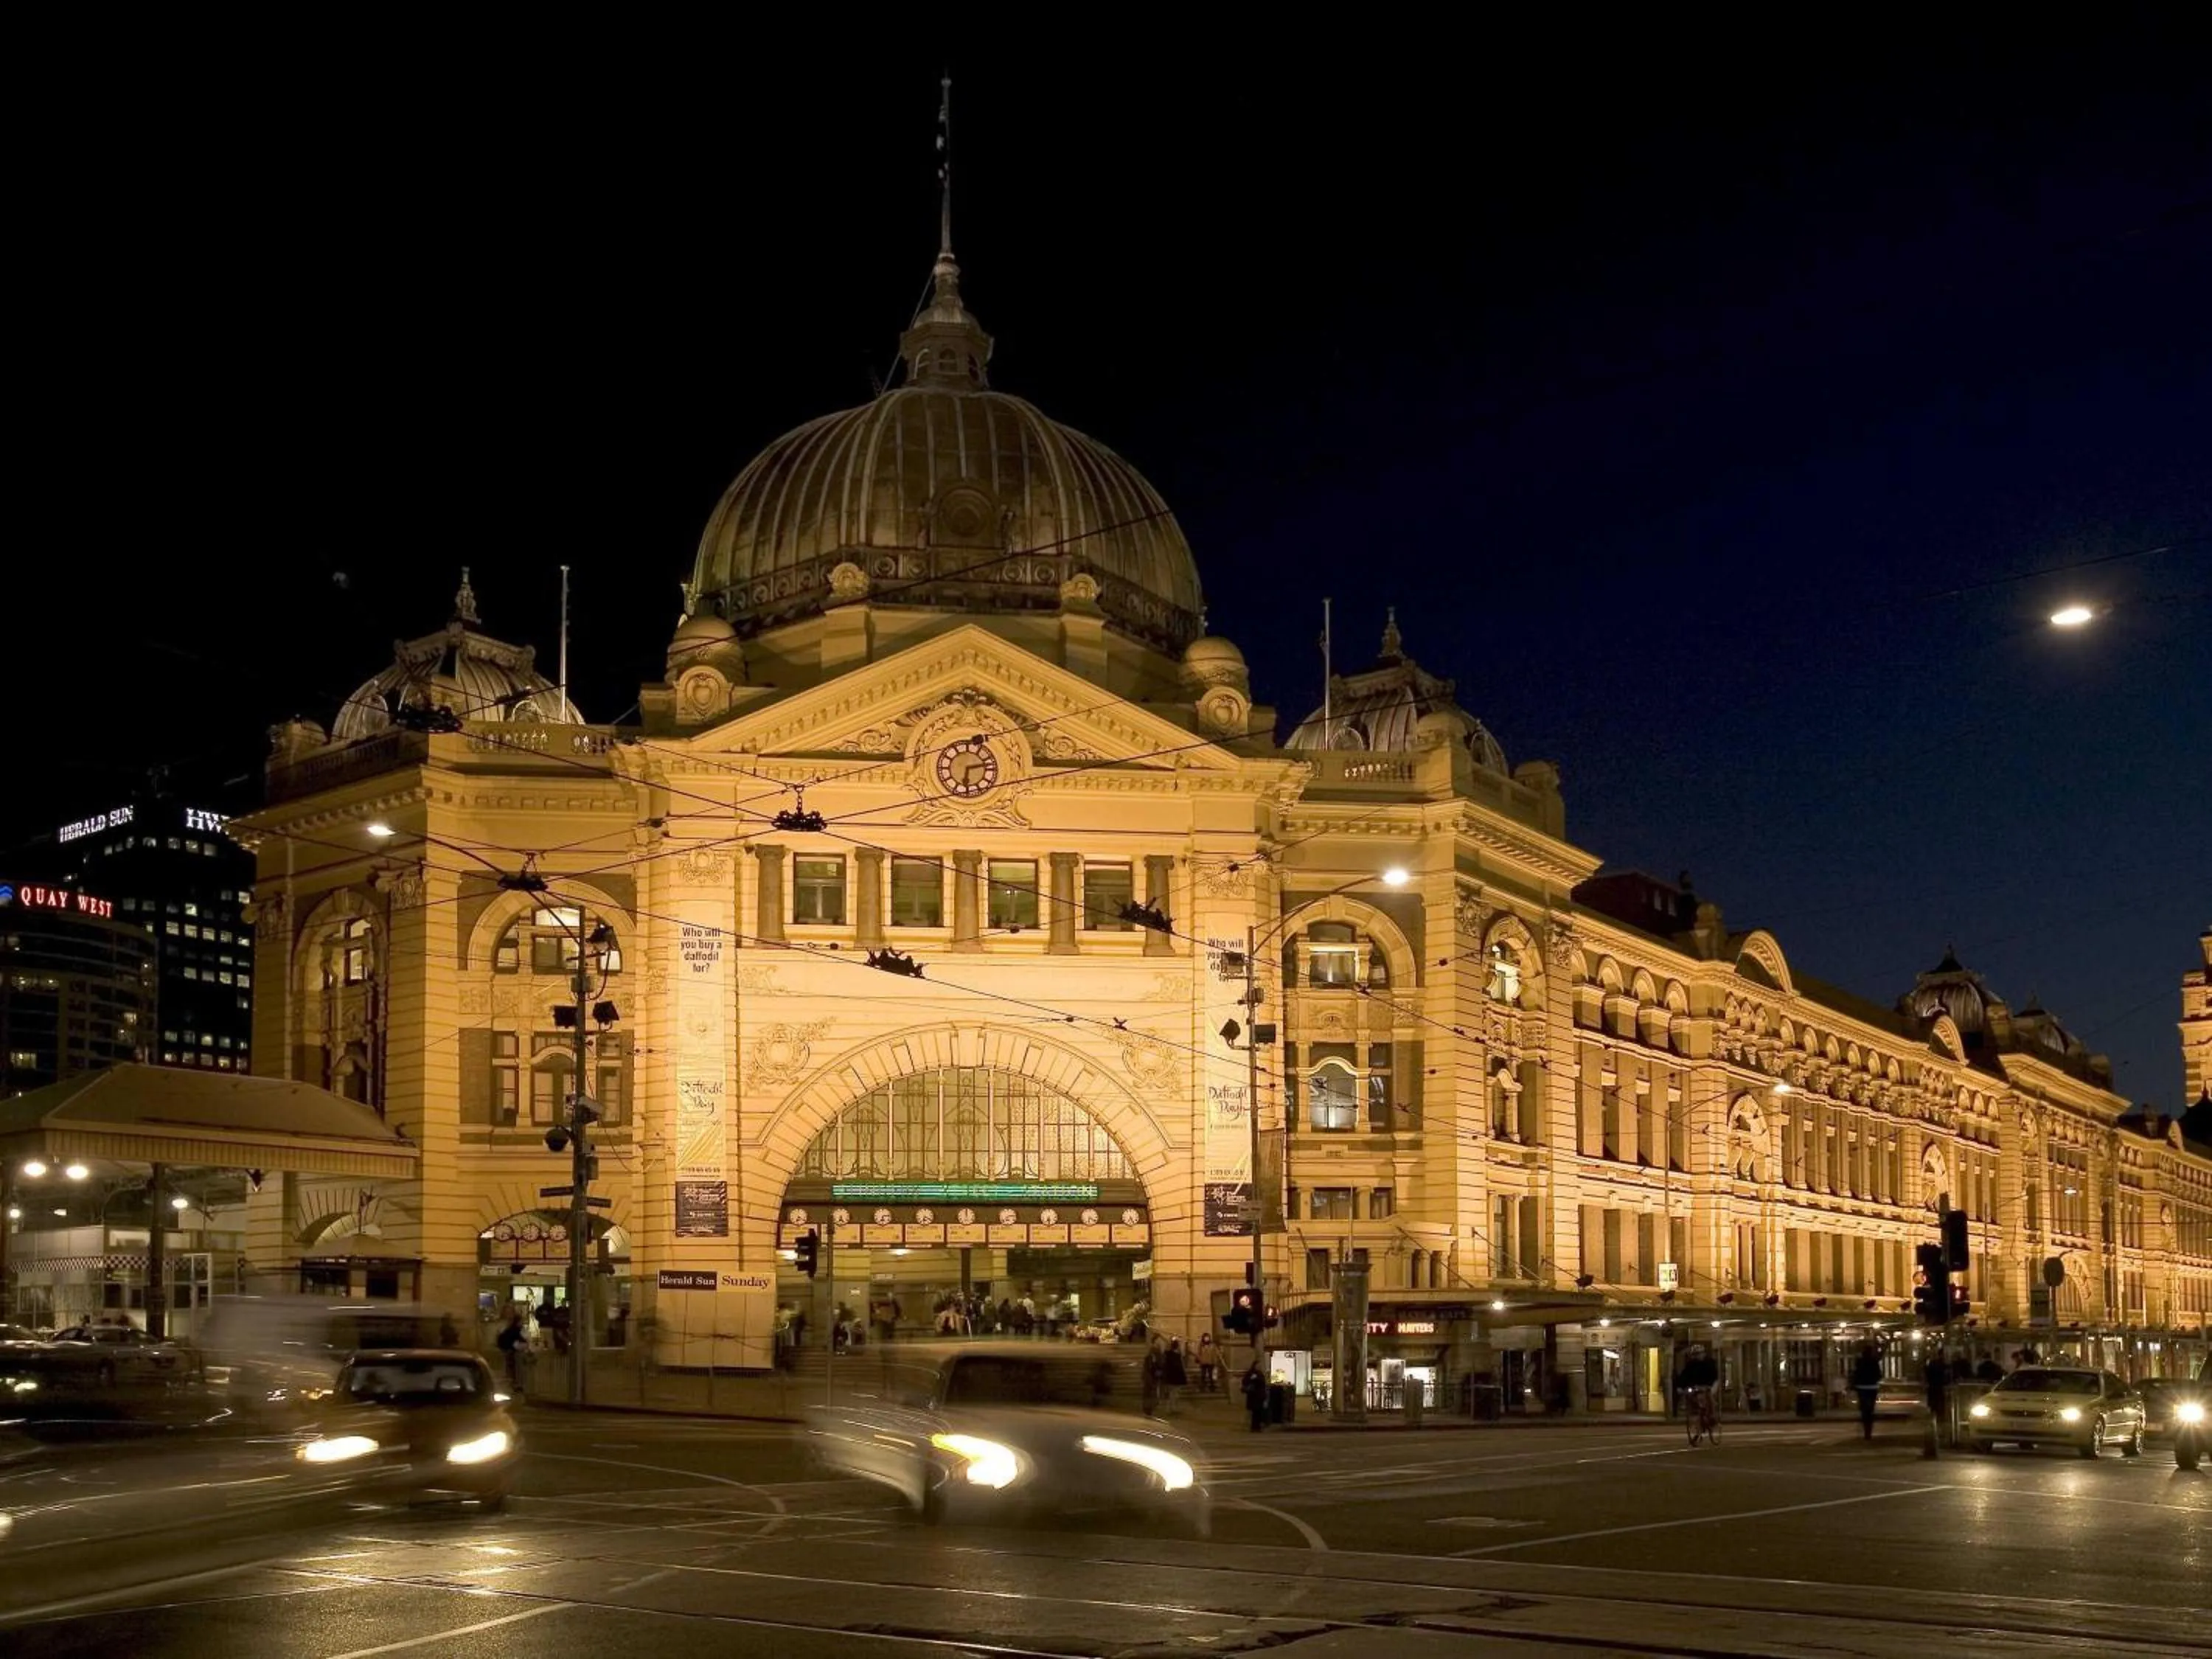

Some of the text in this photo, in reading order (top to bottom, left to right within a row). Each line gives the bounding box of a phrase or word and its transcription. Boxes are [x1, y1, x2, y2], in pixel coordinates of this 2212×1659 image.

[59, 804, 134, 843] HERALD SUN
[21, 886, 113, 918] QUAY WEST
[682, 928, 720, 937] Who will
[681, 940, 697, 950] you
[698, 939, 714, 950] buy
[1208, 938, 1243, 947] Who will
[684, 951, 719, 961] daffodil
[692, 963, 710, 973] for?
[660, 1275, 715, 1285] Herald Sun
[722, 1275, 769, 1289] Sunday
[1397, 1322, 1434, 1333] MATTERS
